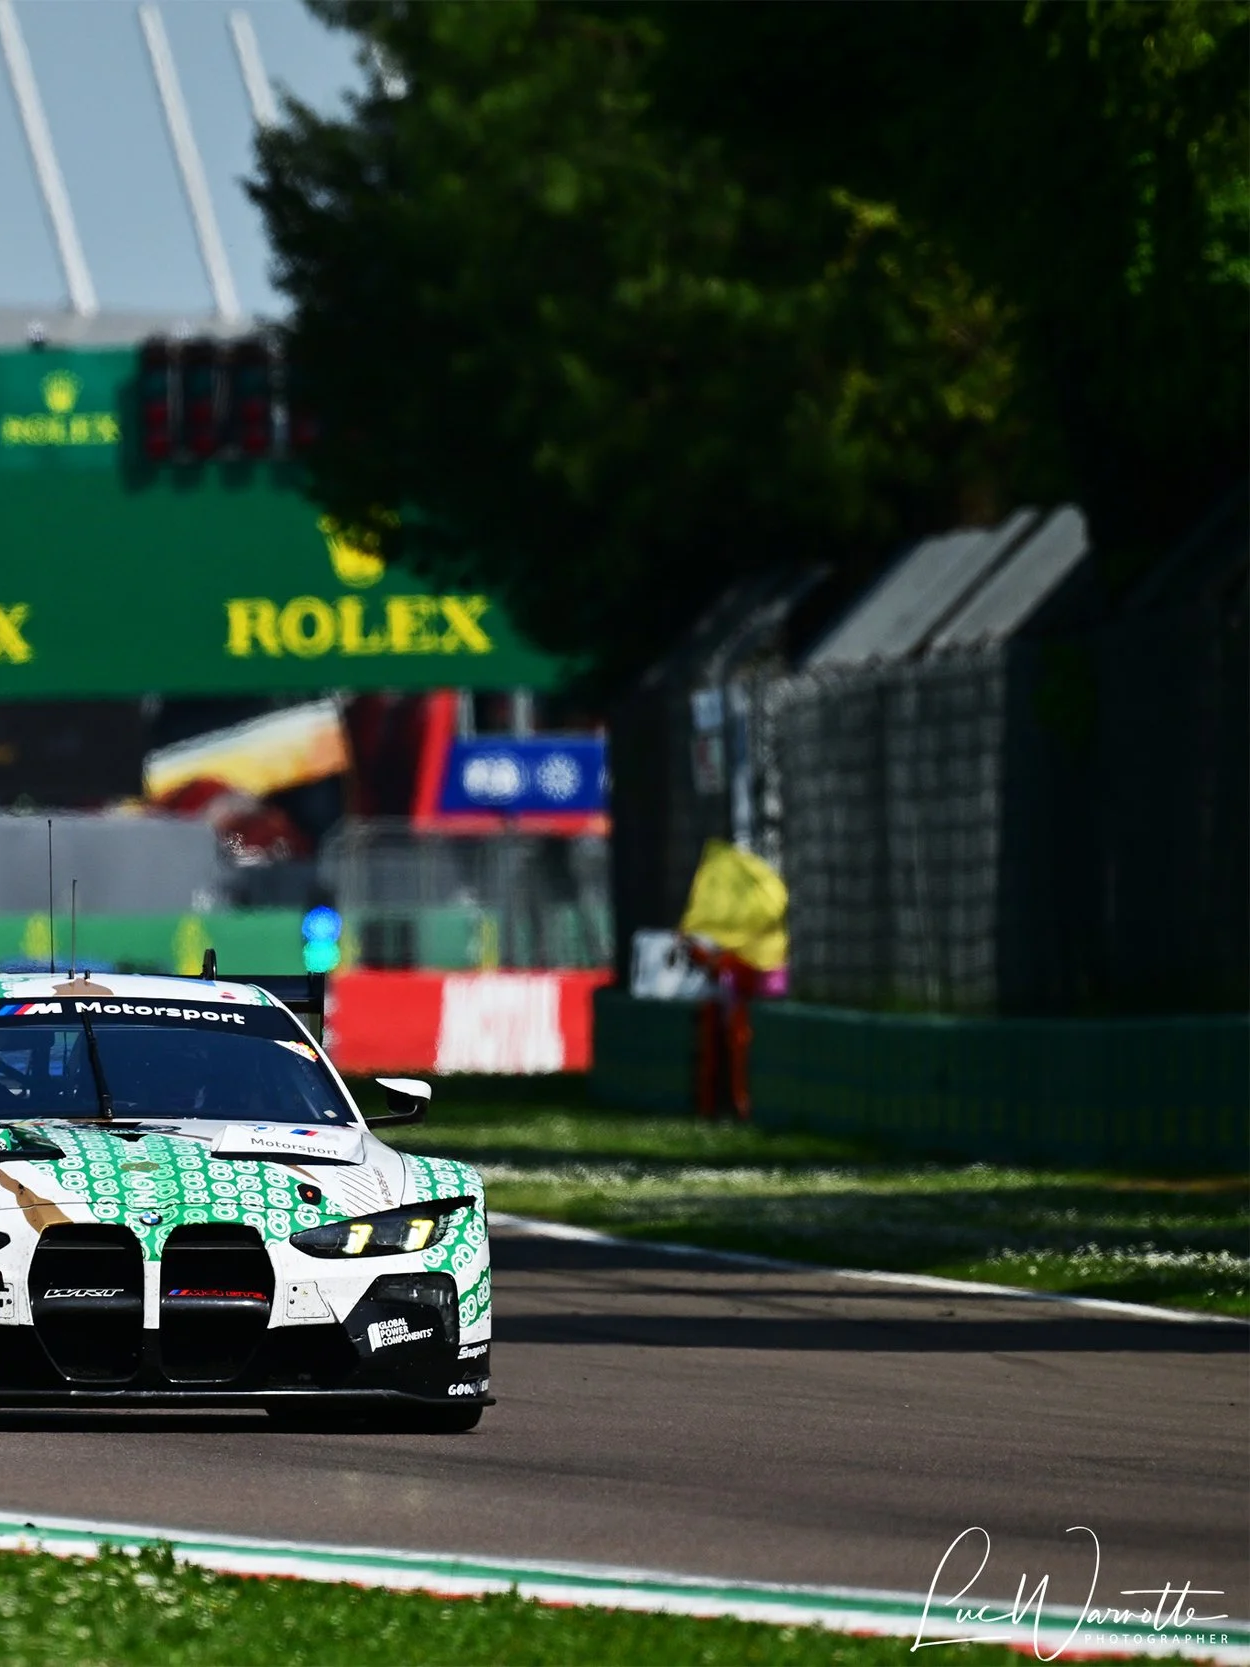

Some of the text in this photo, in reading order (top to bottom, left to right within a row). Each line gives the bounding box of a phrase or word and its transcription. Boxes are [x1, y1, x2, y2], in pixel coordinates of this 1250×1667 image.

[1, 412, 120, 446] ROLEX
[226, 593, 491, 657] ROLEX
[75, 1002, 246, 1025] Motorsport
[250, 1137, 339, 1157] Motorsport
[43, 1288, 124, 1299] WRT
[378, 1317, 408, 1330] GLOBAL
[379, 1325, 409, 1338] POWER
